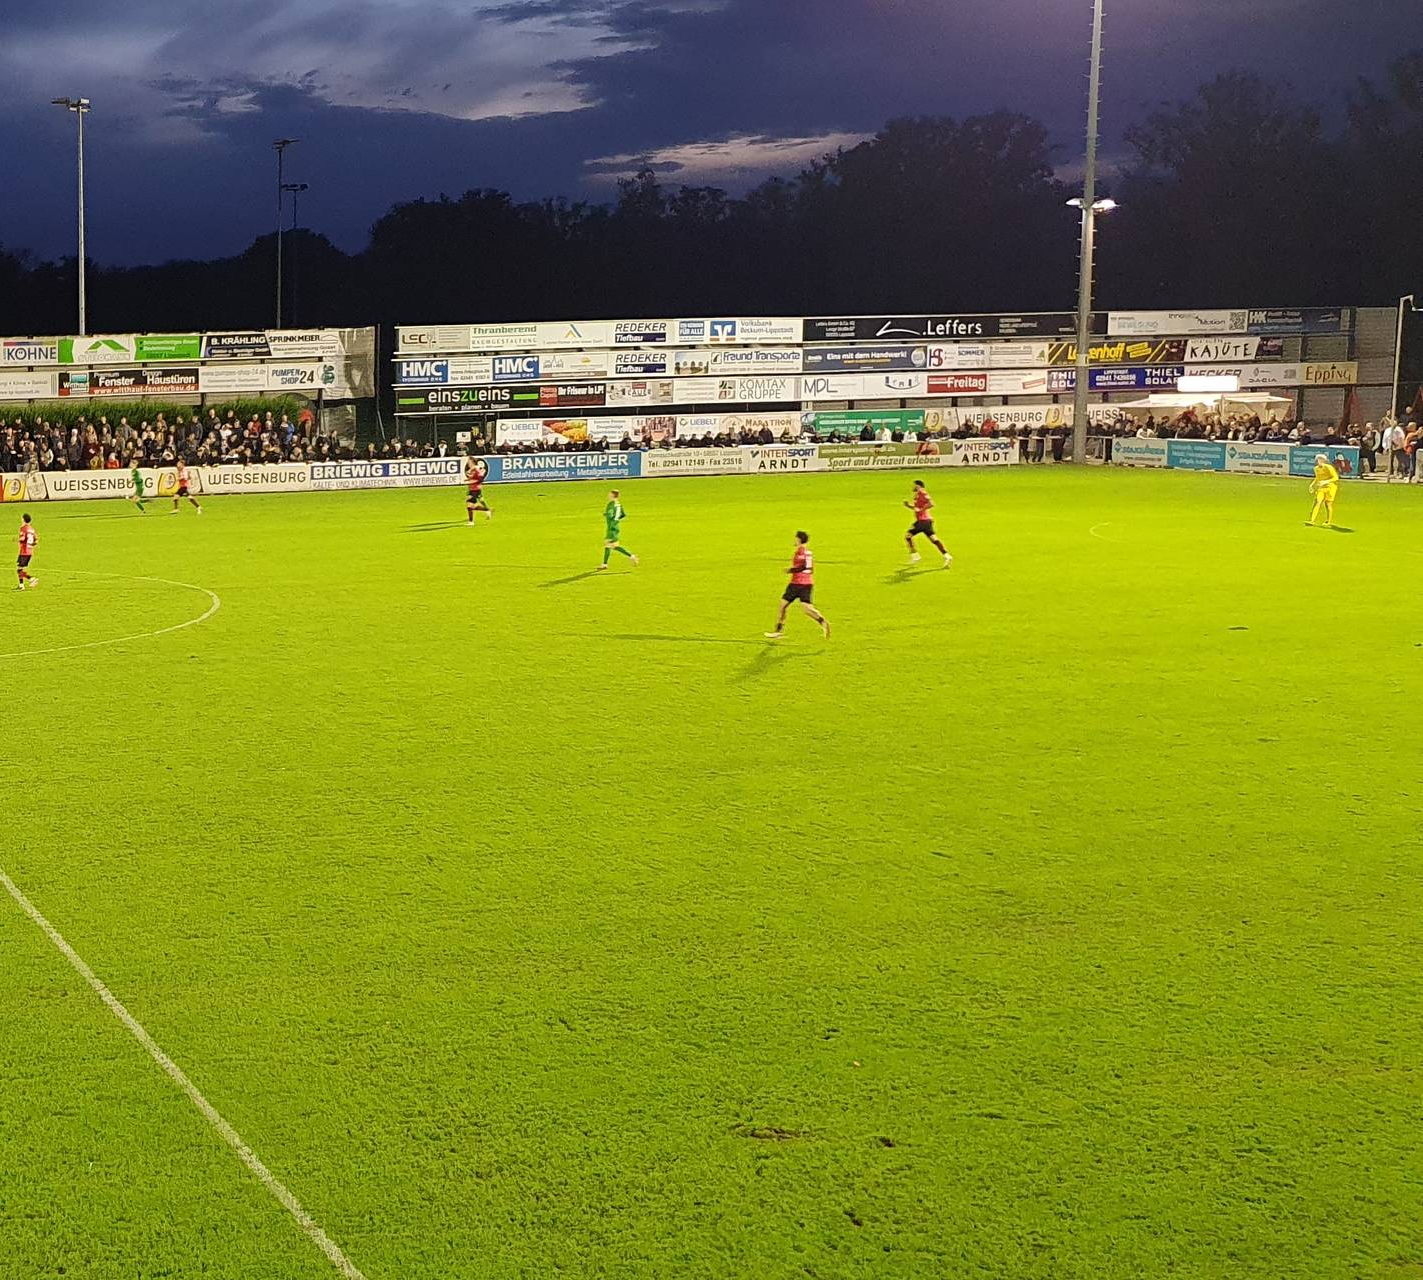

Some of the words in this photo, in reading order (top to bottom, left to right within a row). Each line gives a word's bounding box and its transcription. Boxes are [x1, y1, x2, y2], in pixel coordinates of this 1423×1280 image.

[615, 323, 667, 333] REDEKER
[927, 320, 982, 335] Leffers
[221, 336, 266, 345] KRÄHLING
[268, 335, 320, 343] SPRINKMEIER
[7, 347, 56, 360] KÖHNE
[723, 351, 753, 361] Freund
[755, 351, 801, 361] Transporte
[1190, 342, 1253, 359] KAJÜTE
[615, 353, 667, 363] REDEKER
[402, 360, 443, 377] HMC
[494, 357, 534, 374] HMC
[299, 370, 315, 384] 24
[1145, 368, 1181, 377] THIEL
[99, 377, 135, 387] Fenster
[147, 375, 195, 385] Haustüren
[281, 377, 300, 385] SHOP
[739, 379, 786, 389] KOMTAX
[946, 376, 986, 390] Freitag
[1145, 377, 1177, 385] SOLAR
[428, 386, 510, 404] einszueins
[739, 388, 781, 399] GRUPPE
[760, 448, 816, 458] INTERSPORT
[961, 452, 1010, 463] ARNDT
[502, 454, 628, 470] BRANNEKEMPER
[662, 459, 683, 467] 02941
[709, 458, 721, 466] Fax
[758, 459, 809, 470] ARNDT
[827, 457, 852, 468] Sport
[853, 456, 870, 466] und
[871, 455, 905, 465] Freizeit
[907, 454, 941, 464] erleben
[313, 464, 384, 479] BRIEWIG
[388, 460, 458, 476] BRIEWIG
[208, 471, 306, 485] WEISSENBURG
